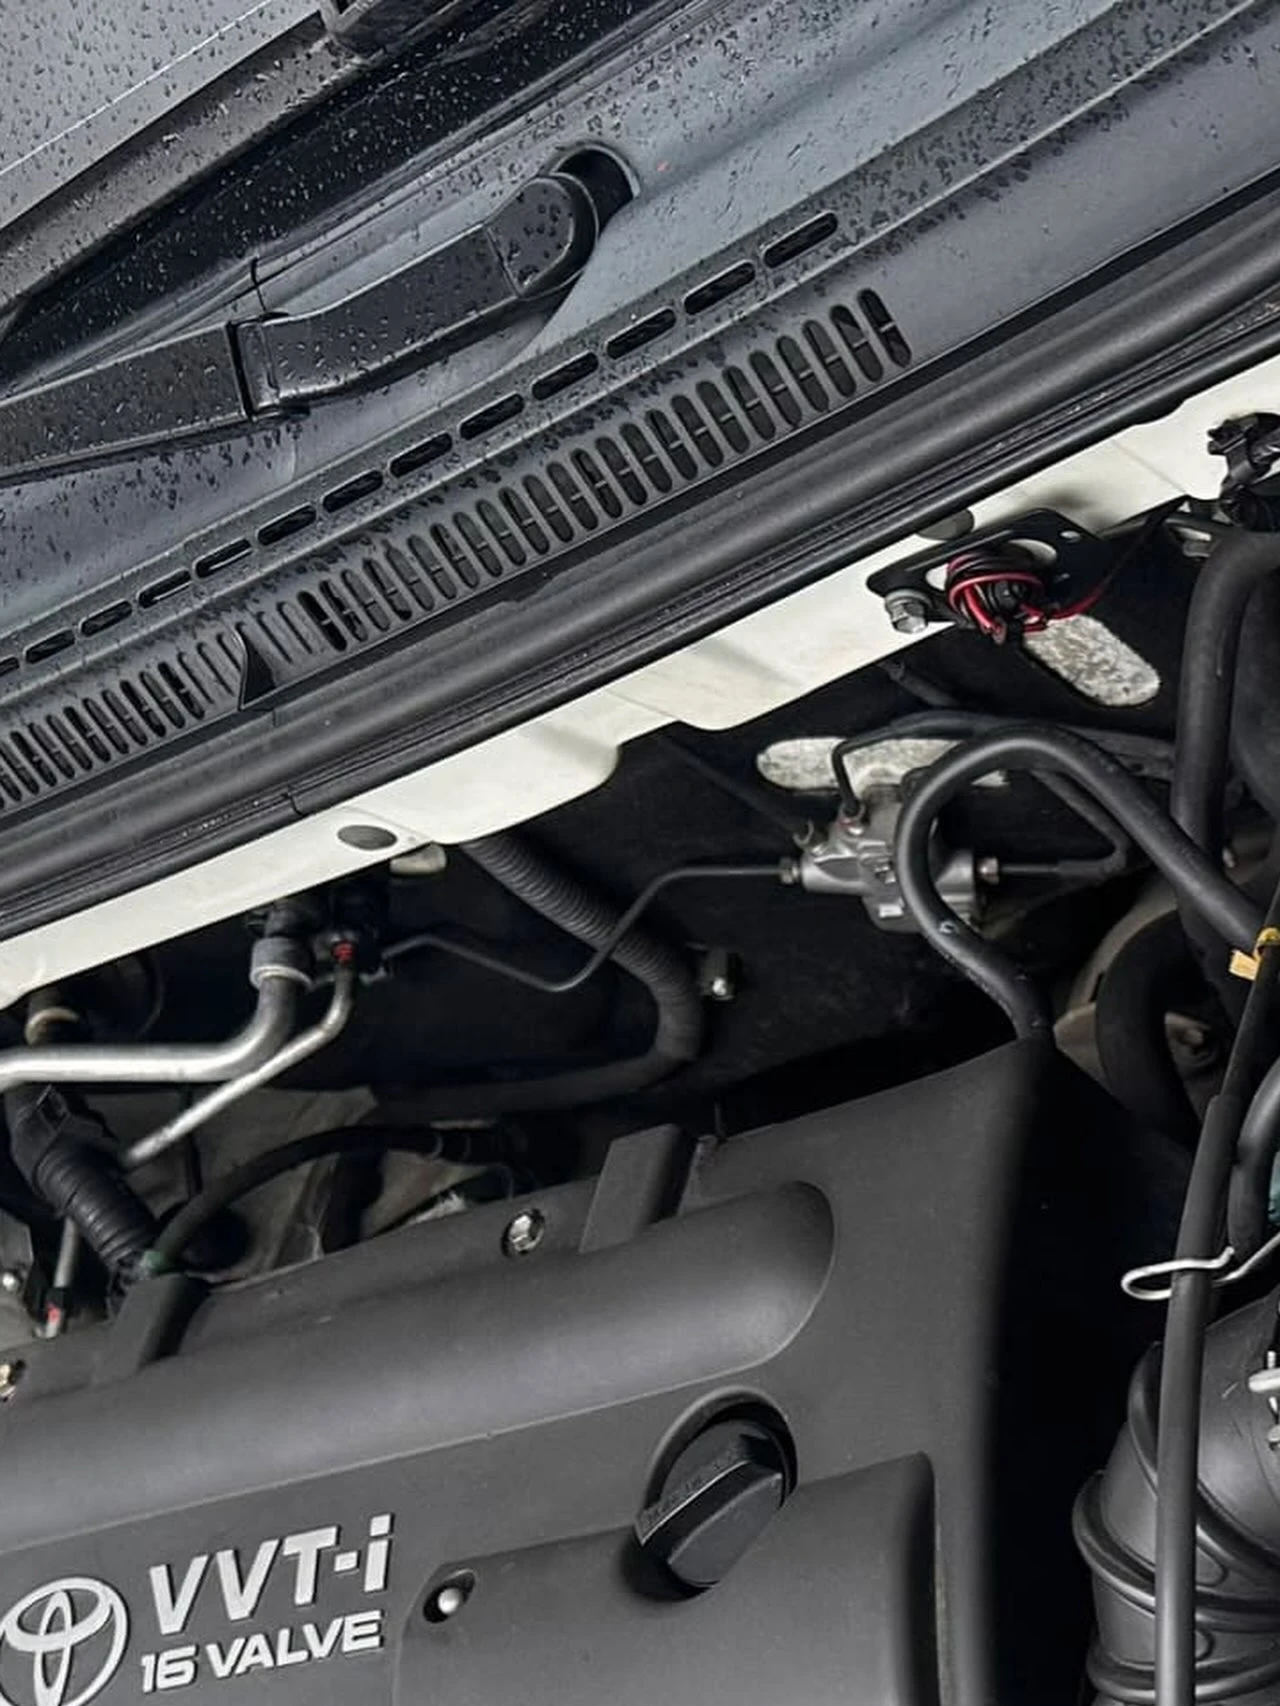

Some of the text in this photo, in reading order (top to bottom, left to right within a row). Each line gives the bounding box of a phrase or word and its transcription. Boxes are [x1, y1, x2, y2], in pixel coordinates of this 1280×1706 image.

[149, 1514, 392, 1635] VVT-i
[140, 1609, 384, 1693] 16 VALVE
